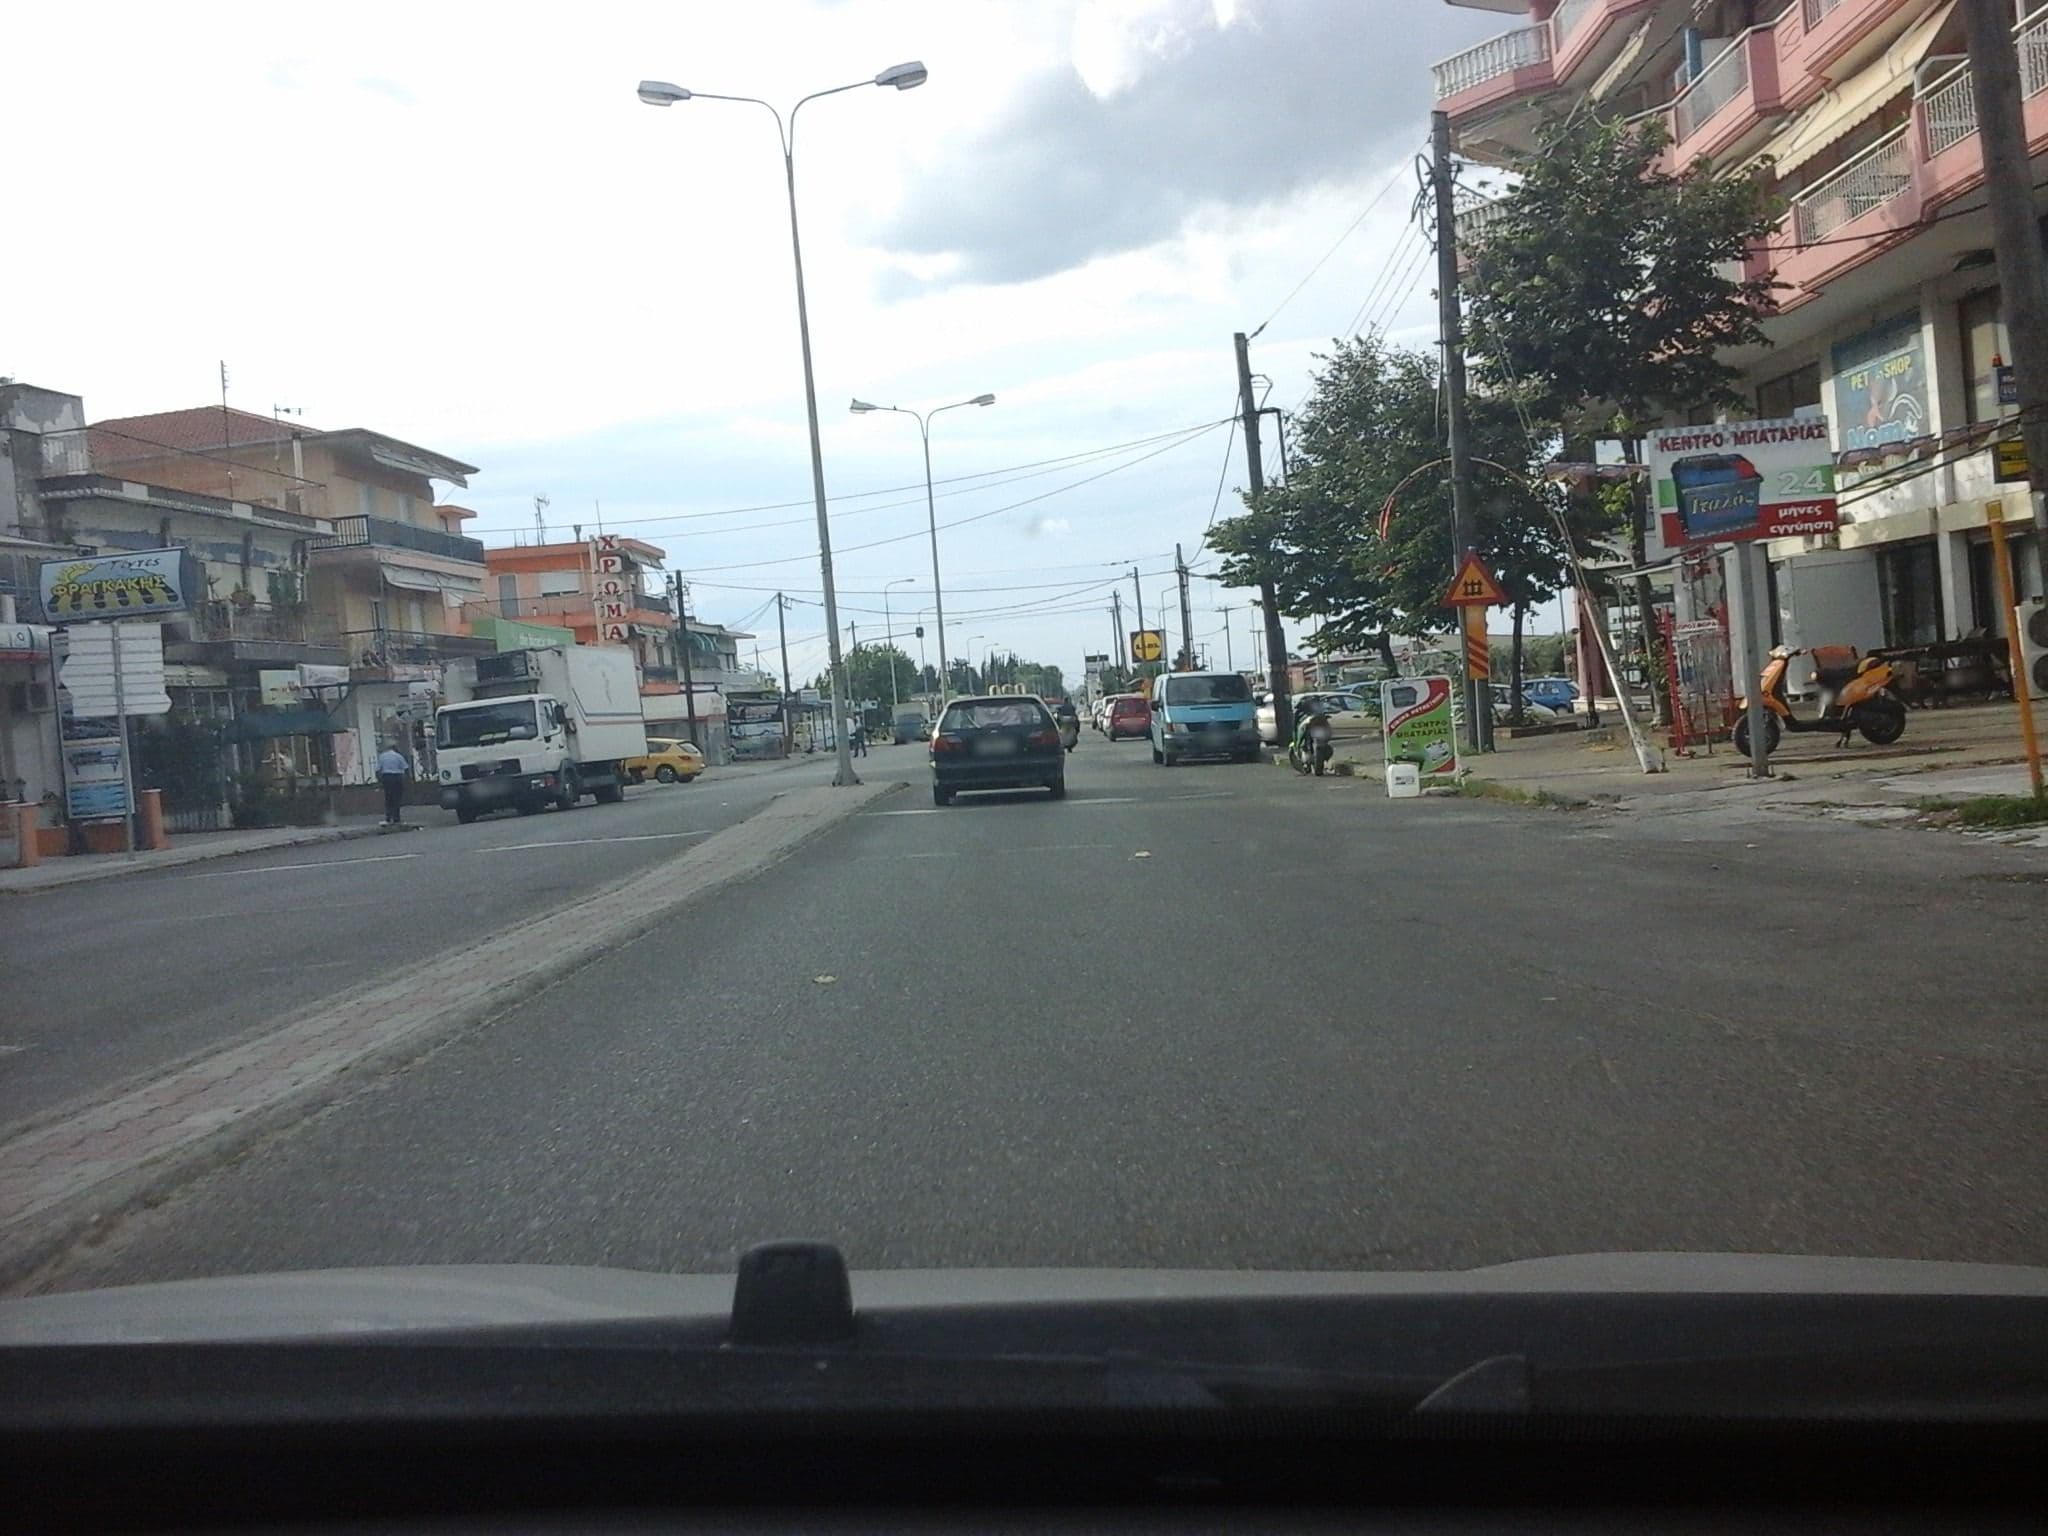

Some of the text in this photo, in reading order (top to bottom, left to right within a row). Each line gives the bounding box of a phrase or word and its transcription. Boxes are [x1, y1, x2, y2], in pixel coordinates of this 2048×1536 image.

[1850, 355, 1912, 391] PET SHOP
[1659, 433, 1724, 452] ΚΕΝΤΡΟ
[1733, 423, 1827, 446] ΜΠΑΤΑΡΙΑΣ
[1778, 470, 1827, 496] 24
[1778, 503, 1823, 518] μήνες
[1769, 519, 1834, 534] εγγύηση
[51, 574, 166, 596] ΦΡΑΓΚΑΚΗΣ
[601, 535, 624, 640] ΧΡΩΜΑ
